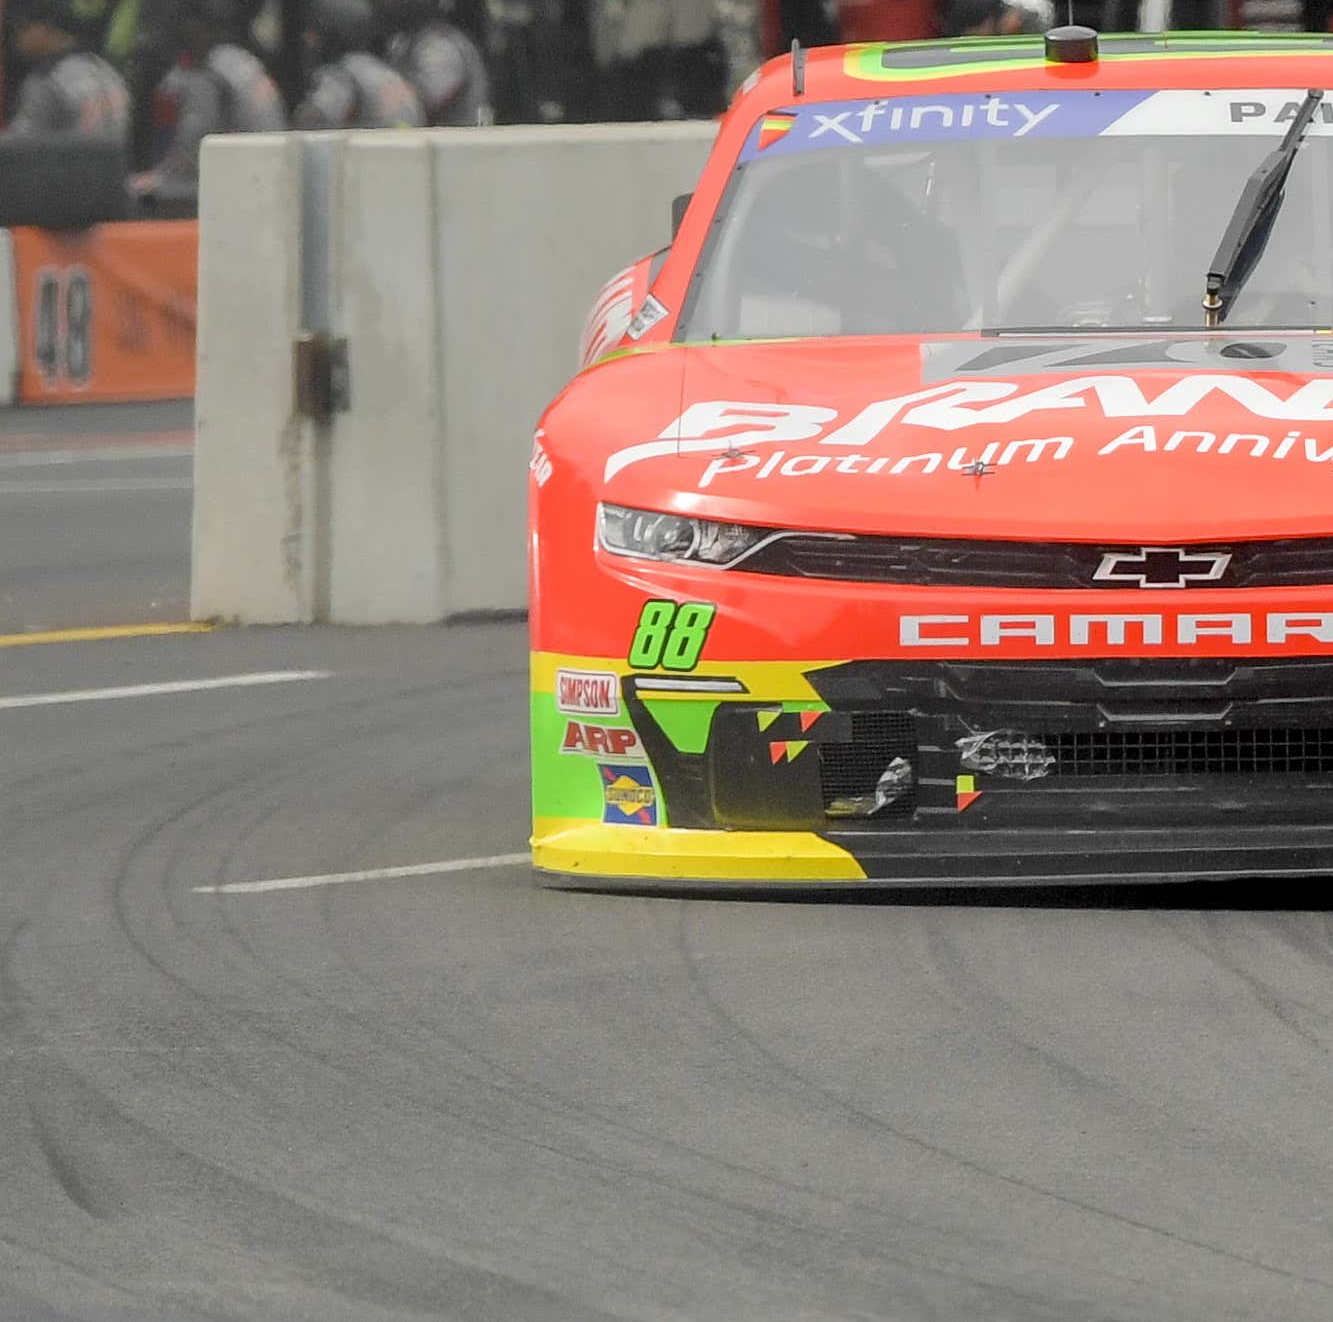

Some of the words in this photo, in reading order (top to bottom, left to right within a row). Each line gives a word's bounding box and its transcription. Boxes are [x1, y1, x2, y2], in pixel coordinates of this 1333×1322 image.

[807, 96, 1061, 144] xfinity
[698, 435, 1072, 488] Platinum
[627, 598, 718, 672] 88
[560, 676, 611, 710] SIMPSON
[563, 721, 637, 755] ARP
